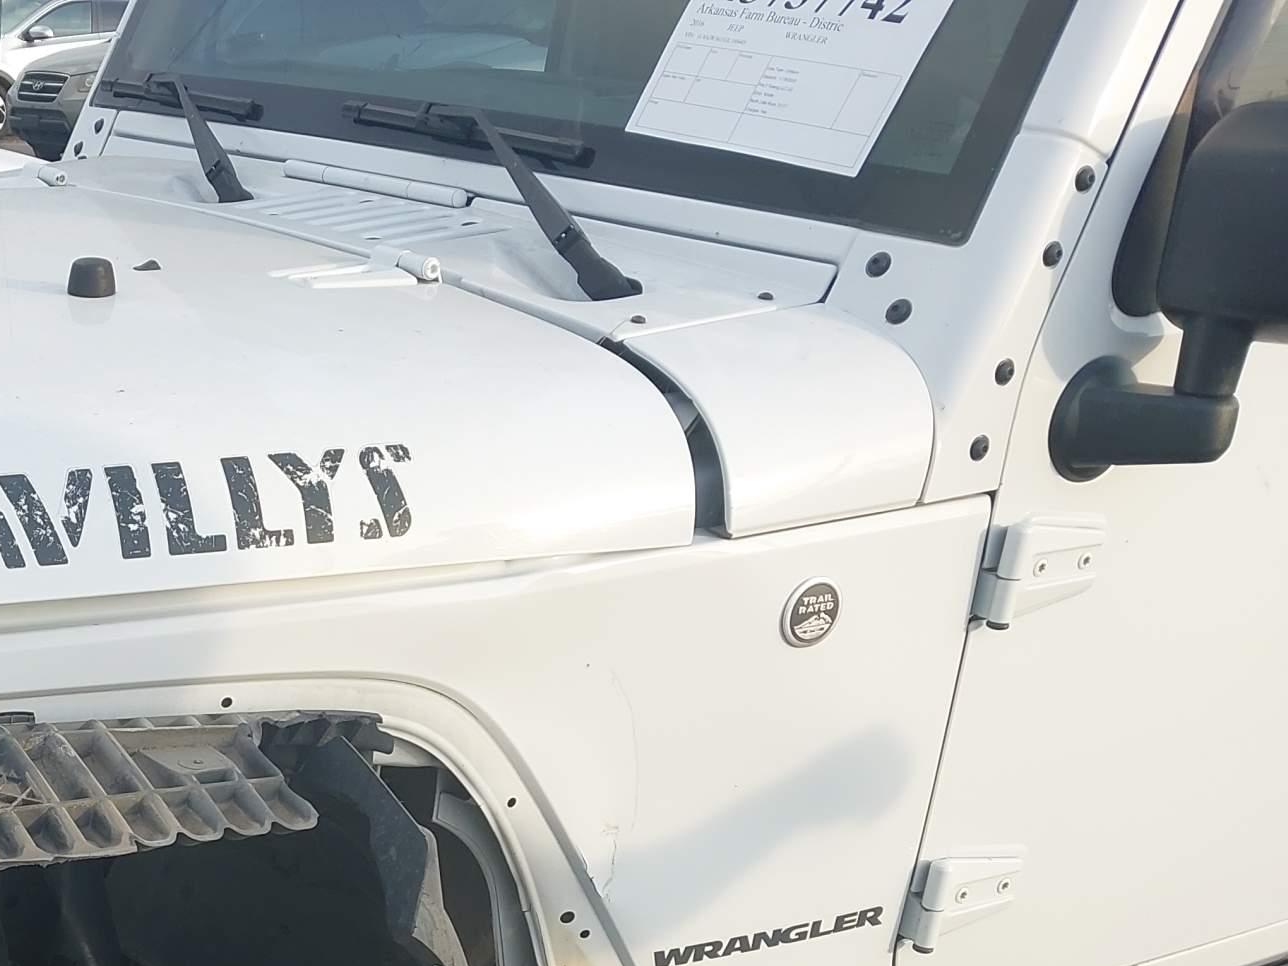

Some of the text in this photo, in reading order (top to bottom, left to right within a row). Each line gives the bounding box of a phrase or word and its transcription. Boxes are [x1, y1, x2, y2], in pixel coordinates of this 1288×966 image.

[697, 3, 738, 18] Arkansas
[739, 8, 763, 22] Farm
[765, 11, 801, 26] Bureau
[809, 16, 845, 32] Distric
[726, 23, 745, 33] JEEP
[785, 31, 828, 45] WRANGLER
[802, 593, 834, 605] TRAIL
[798, 602, 834, 614] RATED
